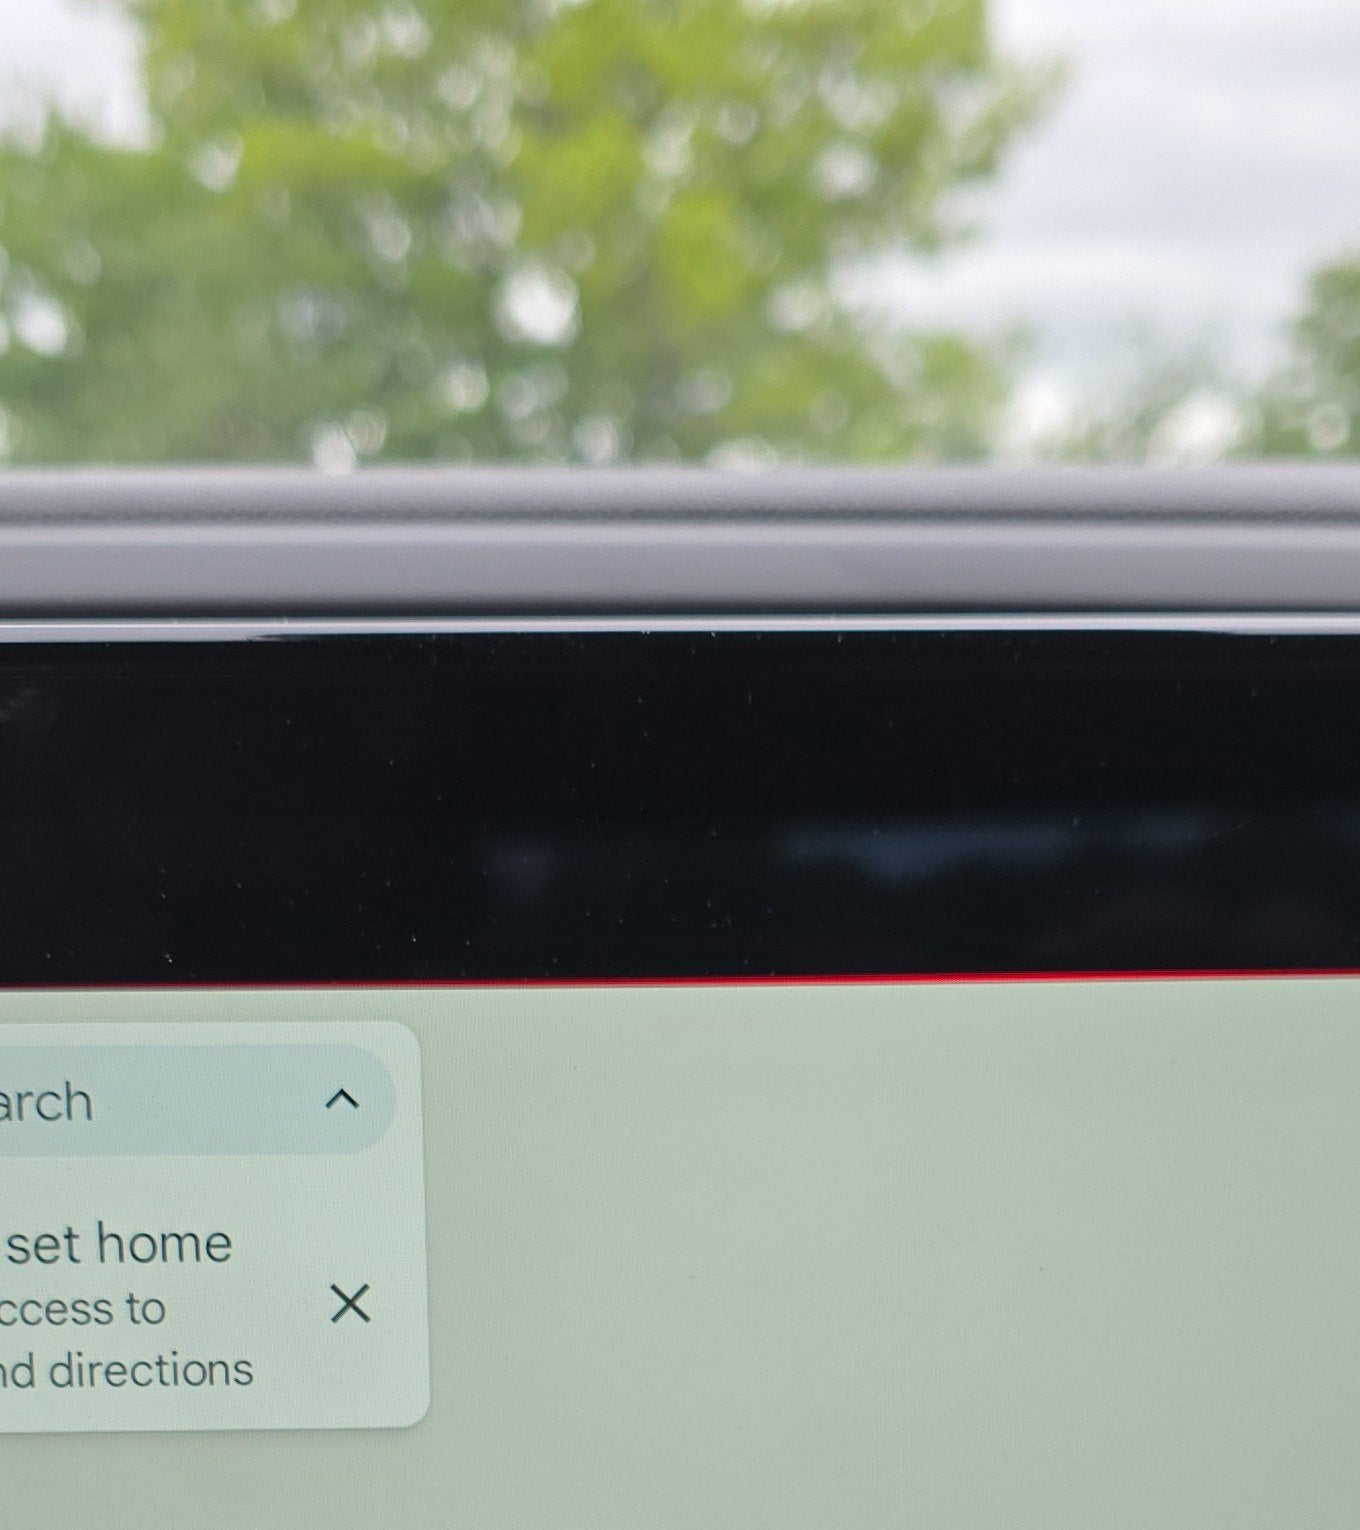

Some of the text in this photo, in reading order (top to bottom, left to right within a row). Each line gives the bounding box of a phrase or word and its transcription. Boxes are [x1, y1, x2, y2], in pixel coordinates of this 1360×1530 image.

[6, 1225, 82, 1265] set
[97, 1219, 233, 1265] home
[124, 1292, 167, 1326] to
[48, 1349, 255, 1388] directions
